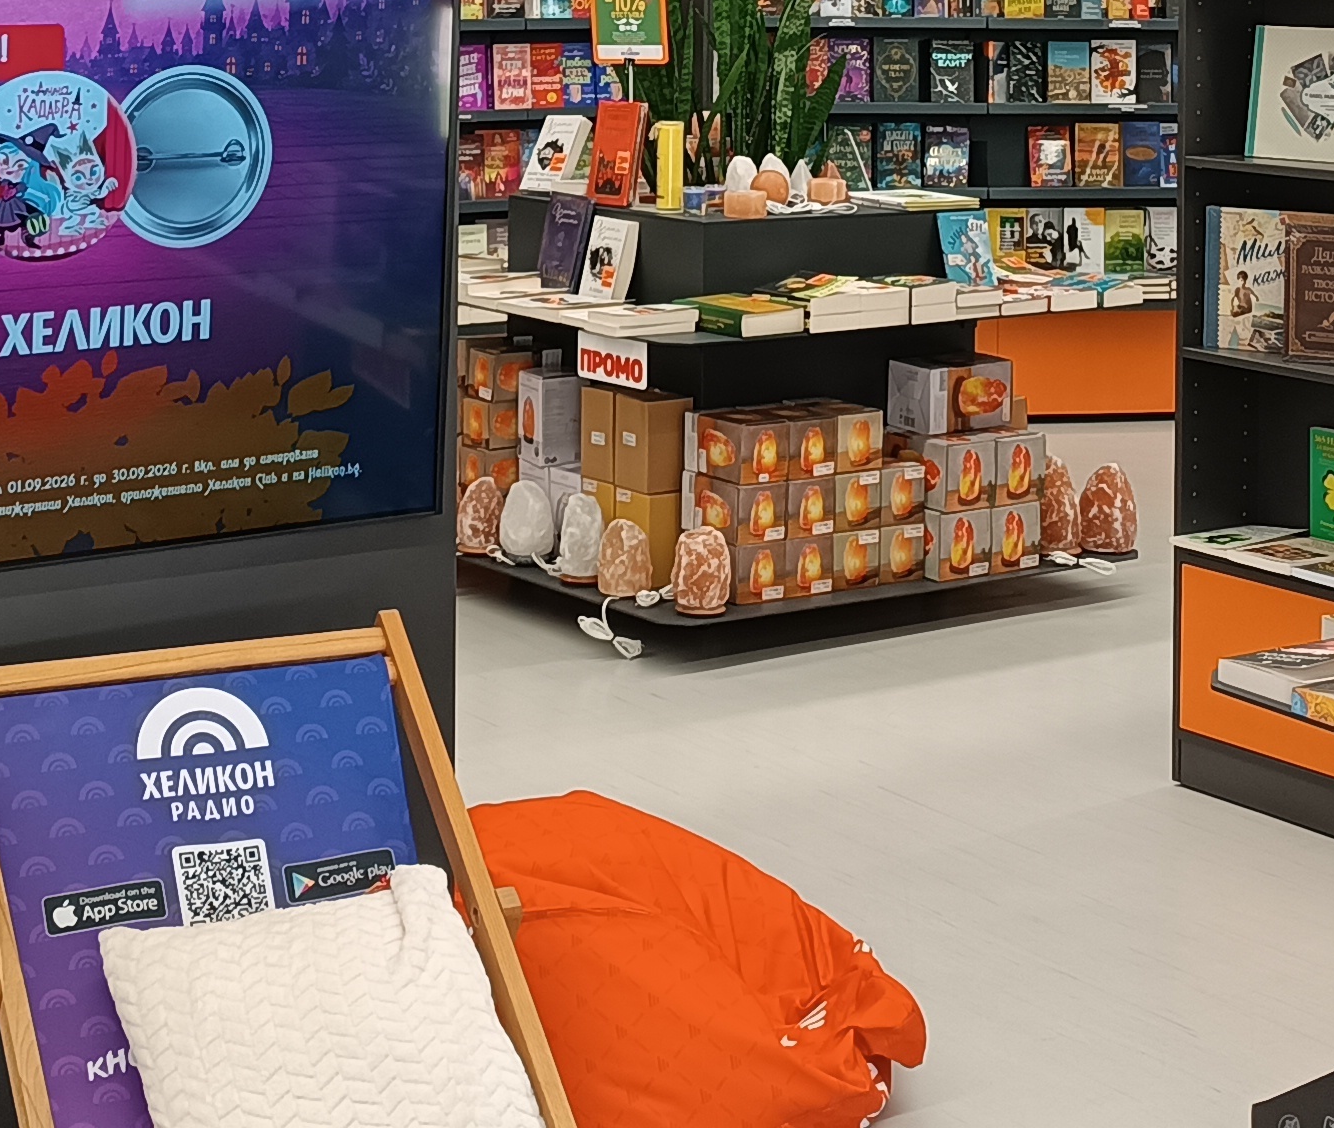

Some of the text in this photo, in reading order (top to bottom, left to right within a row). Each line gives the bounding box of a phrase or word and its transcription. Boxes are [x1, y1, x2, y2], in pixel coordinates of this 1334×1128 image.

[580, 347, 644, 384] ПРОМО
[8, 474, 75, 494] 01.09.2026
[81, 476, 88, 485] г.
[94, 473, 106, 488] до
[112, 462, 177, 483] 30.09.2026
[182, 464, 190, 474] г.
[244, 457, 256, 470] до
[293, 471, 304, 481] на
[139, 760, 275, 801] ХЕЛИКОН
[171, 795, 255, 822] РАДИО
[318, 863, 392, 888] Google play
[79, 885, 156, 906] Download on the
[82, 896, 158, 922] App Store
